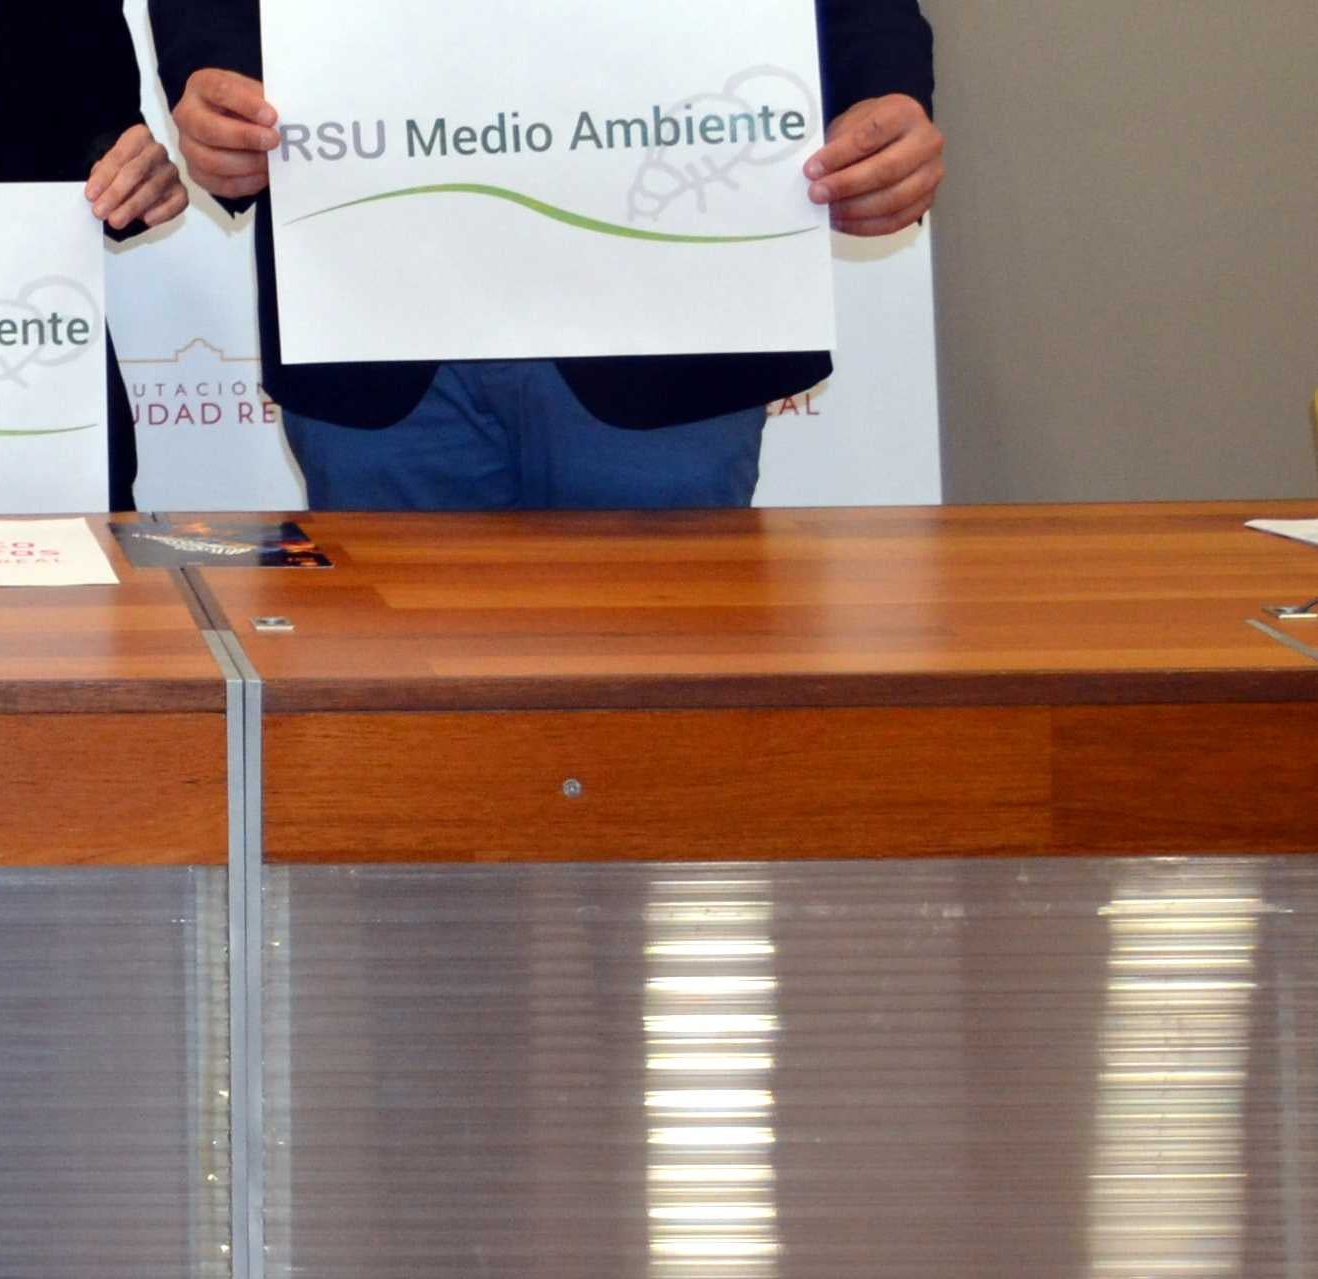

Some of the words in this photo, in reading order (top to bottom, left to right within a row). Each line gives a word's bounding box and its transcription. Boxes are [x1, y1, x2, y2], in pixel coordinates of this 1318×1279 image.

[280, 119, 387, 163] RSU
[405, 111, 554, 158] Medio
[568, 103, 807, 151] Ambiente
